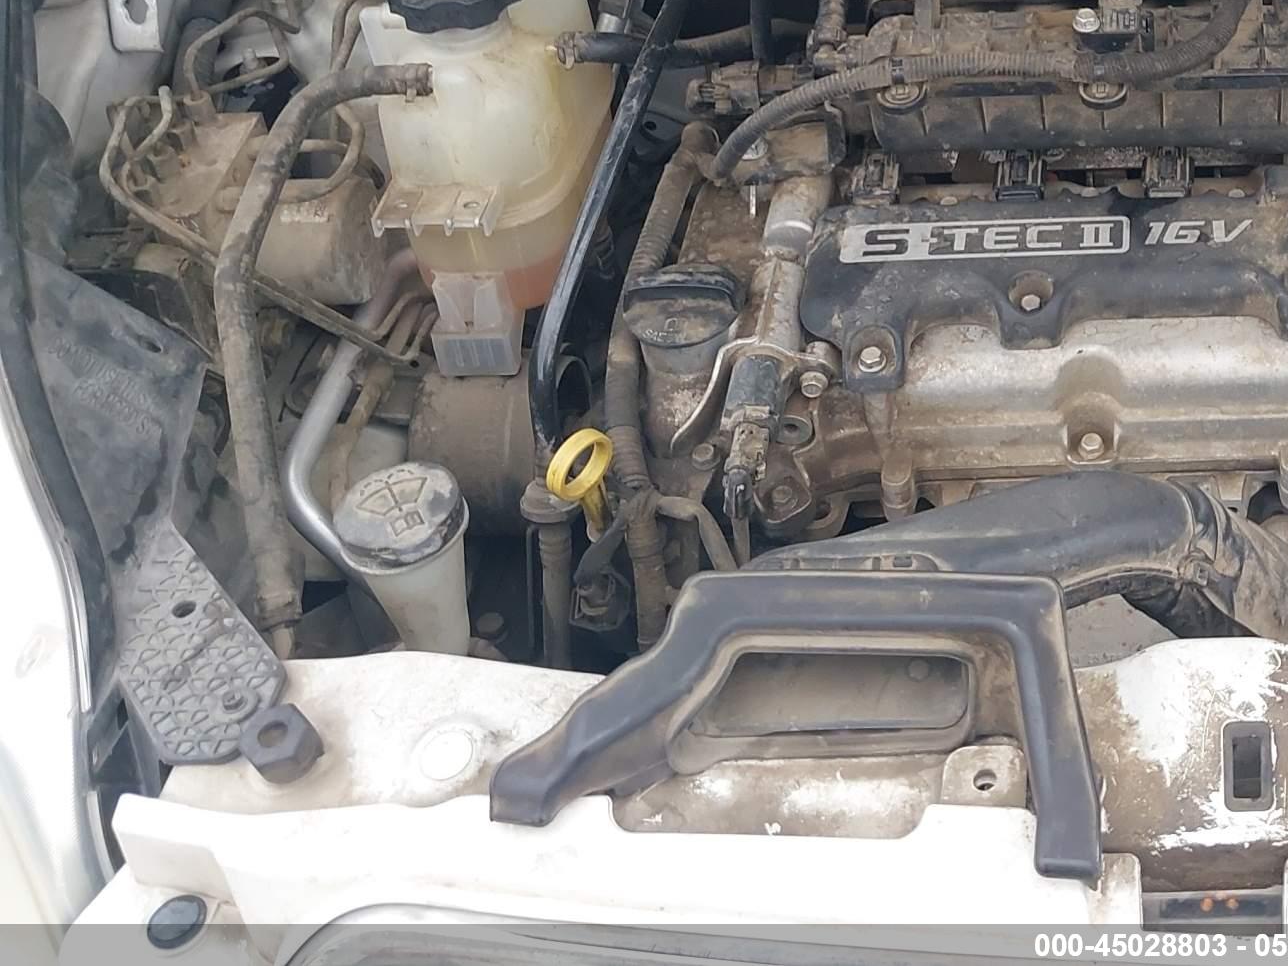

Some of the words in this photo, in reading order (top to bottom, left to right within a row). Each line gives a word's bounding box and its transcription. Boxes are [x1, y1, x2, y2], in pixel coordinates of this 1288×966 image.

[861, 224, 1063, 257] S-TEC
[1079, 223, 1115, 248] II
[1143, 218, 1254, 246] 16V
